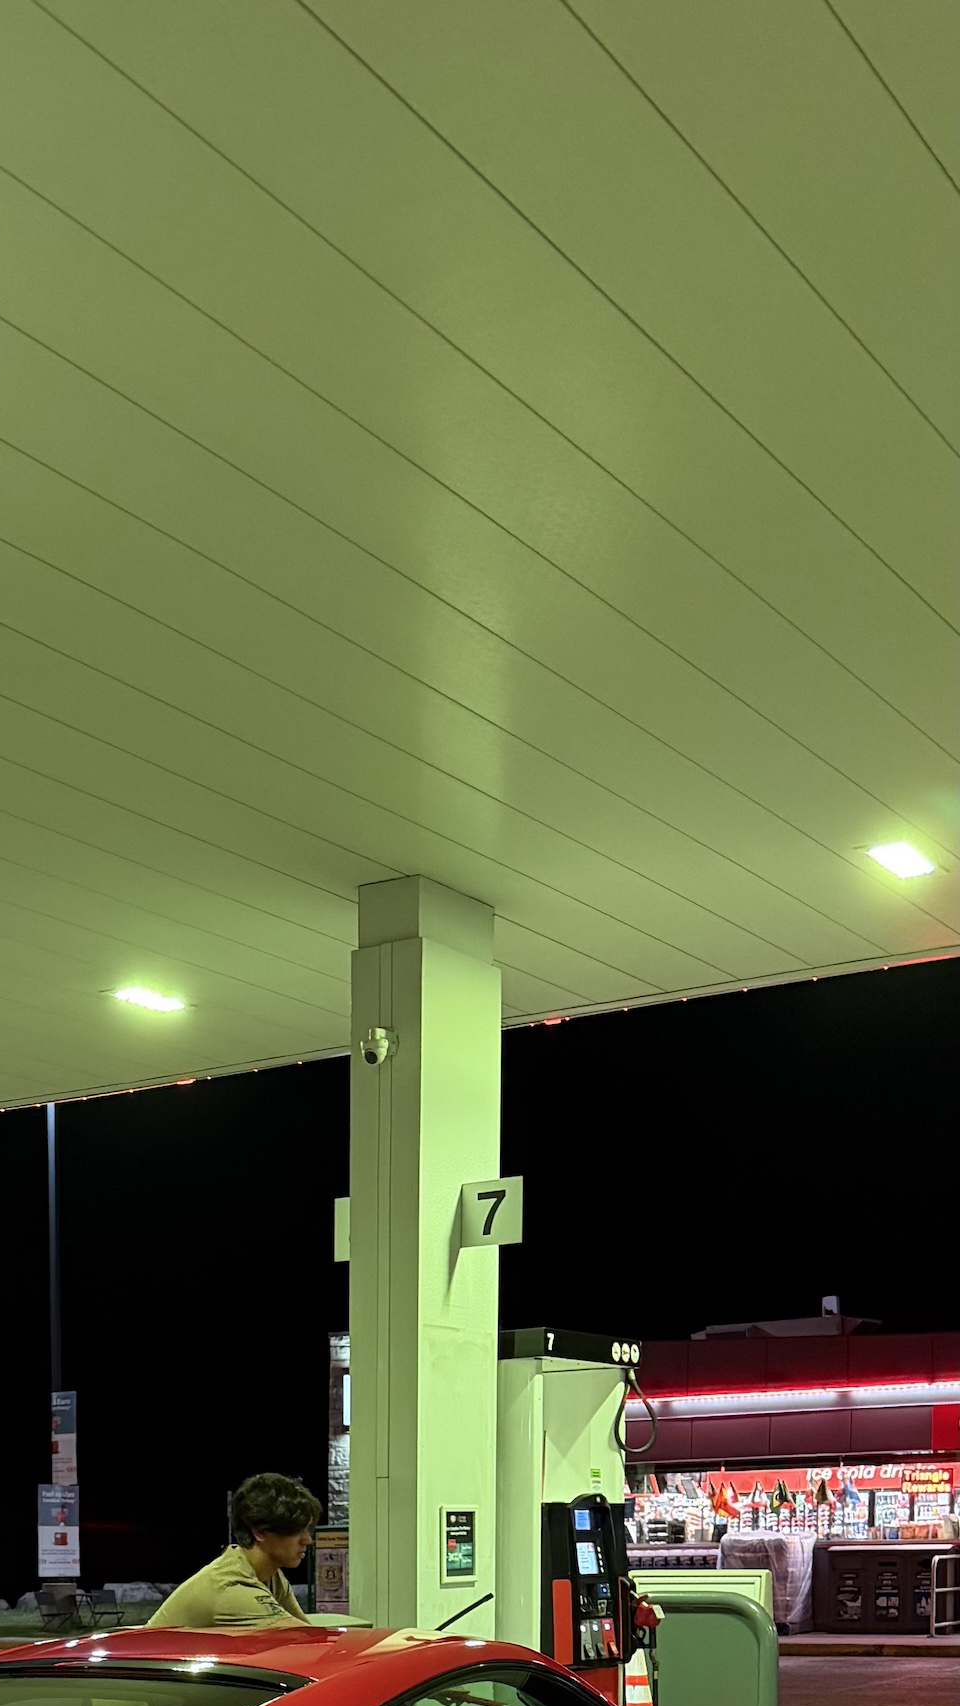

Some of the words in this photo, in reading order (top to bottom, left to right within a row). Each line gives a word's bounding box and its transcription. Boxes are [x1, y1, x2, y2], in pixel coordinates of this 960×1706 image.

[477, 1189, 506, 1236] 7
[546, 1332, 555, 1351] 7
[837, 1465, 876, 1480] cold
[903, 1469, 950, 1483] Triangle
[902, 1482, 951, 1493] Rewards
